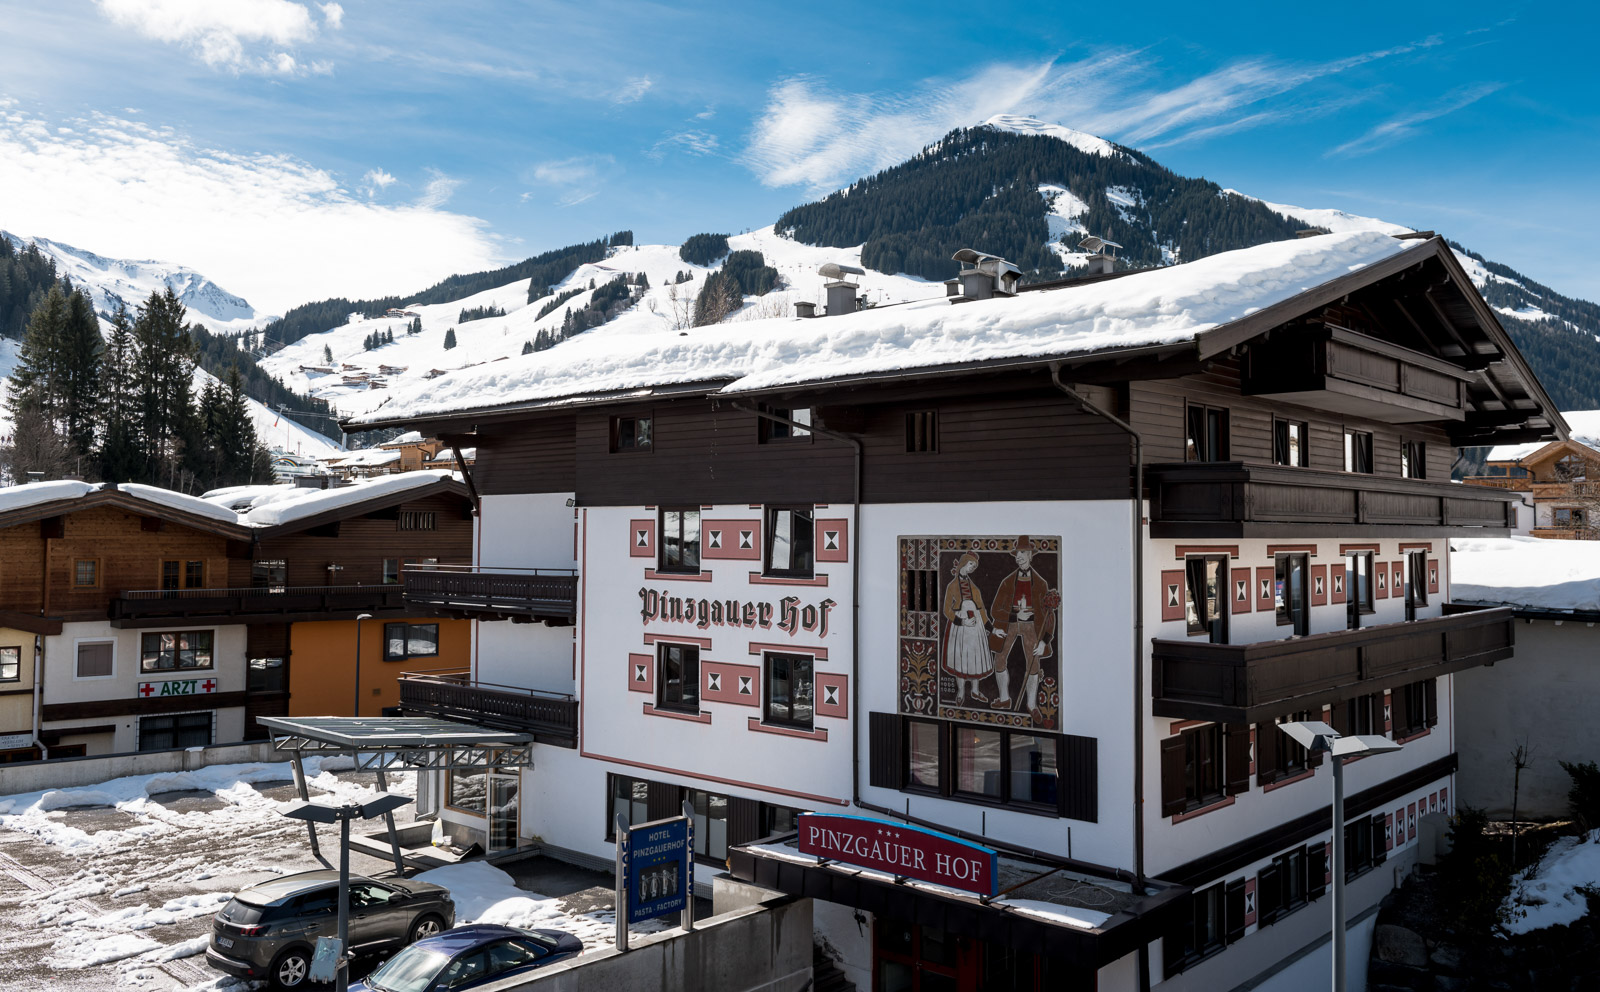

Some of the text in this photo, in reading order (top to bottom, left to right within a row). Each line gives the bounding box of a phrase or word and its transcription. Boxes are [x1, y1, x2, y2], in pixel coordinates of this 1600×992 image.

[638, 587, 837, 639] Pinzgauer Hof
[160, 681, 197, 695] ARZT
[648, 830, 670, 842] HOTEL
[633, 839, 685, 859] PINZGAUERHOF
[809, 826, 982, 882] PINZGAUER HOF
[634, 907, 652, 917] PASTA
[656, 898, 682, 911] FACTORY
